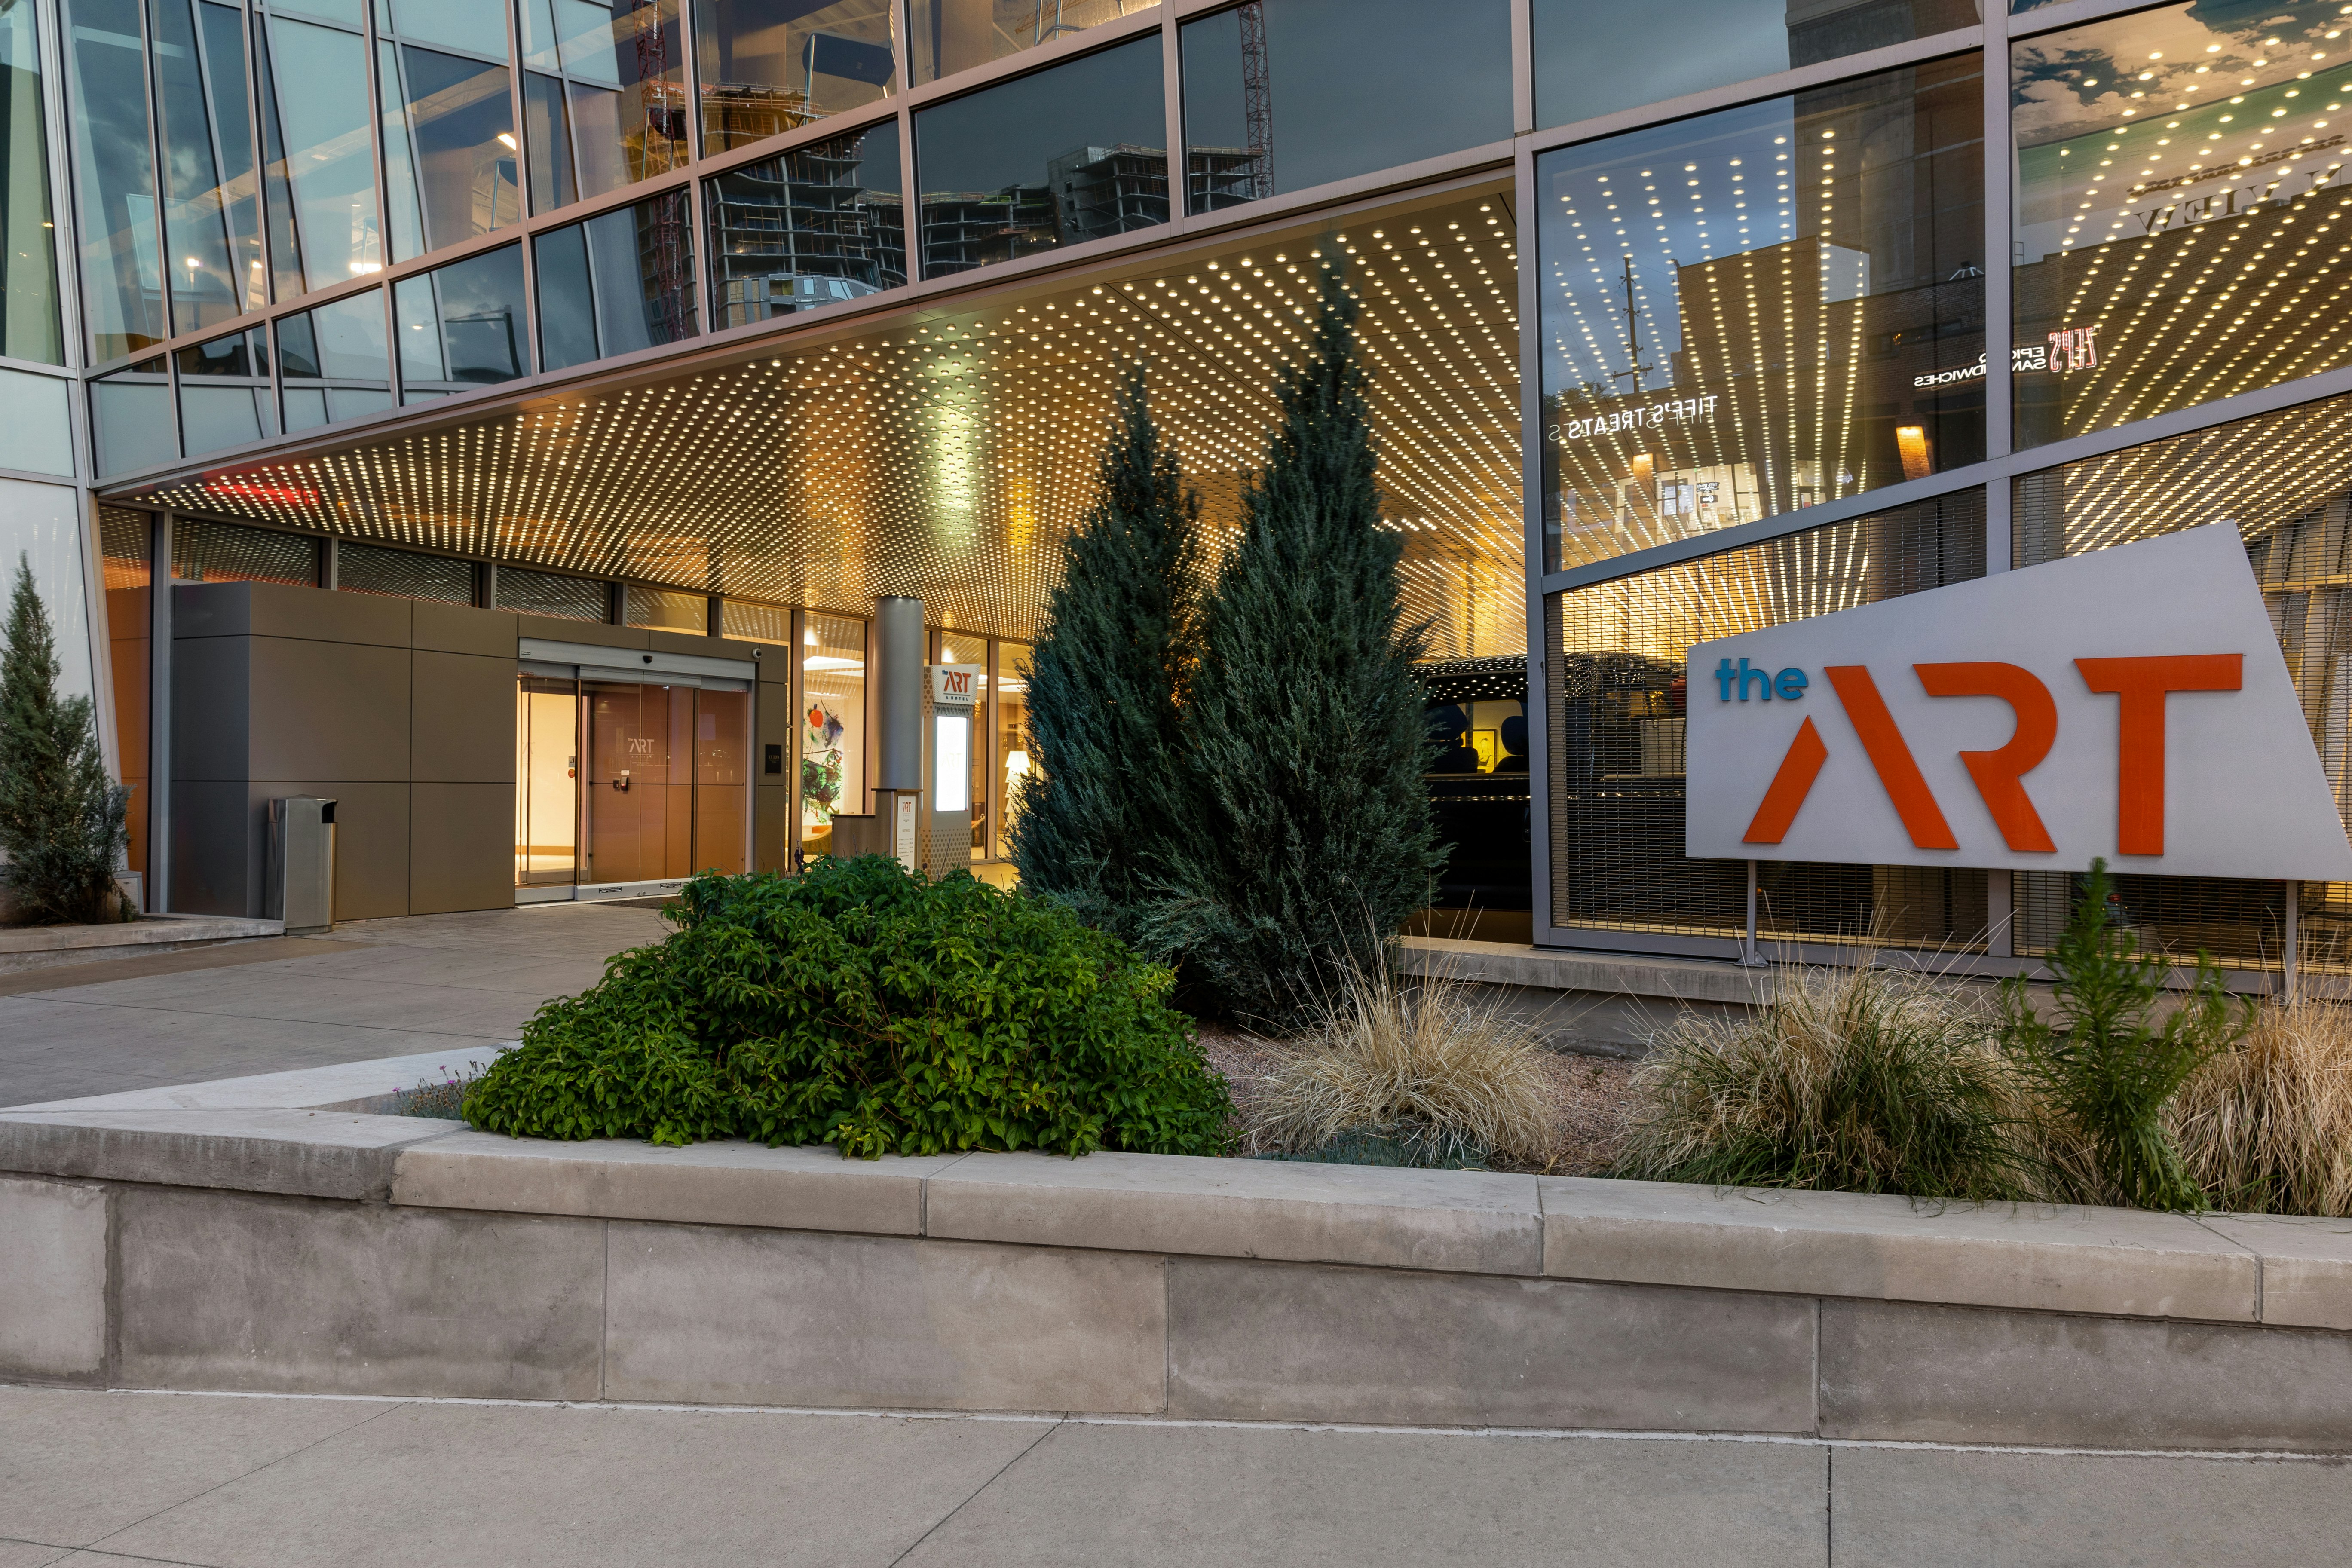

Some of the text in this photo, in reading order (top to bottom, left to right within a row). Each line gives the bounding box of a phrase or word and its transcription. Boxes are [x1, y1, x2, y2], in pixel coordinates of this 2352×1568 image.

[943, 671, 971, 693] ART
[629, 738, 655, 753] ART
[1715, 653, 2244, 856] the ART
[903, 802, 911, 813] ART
